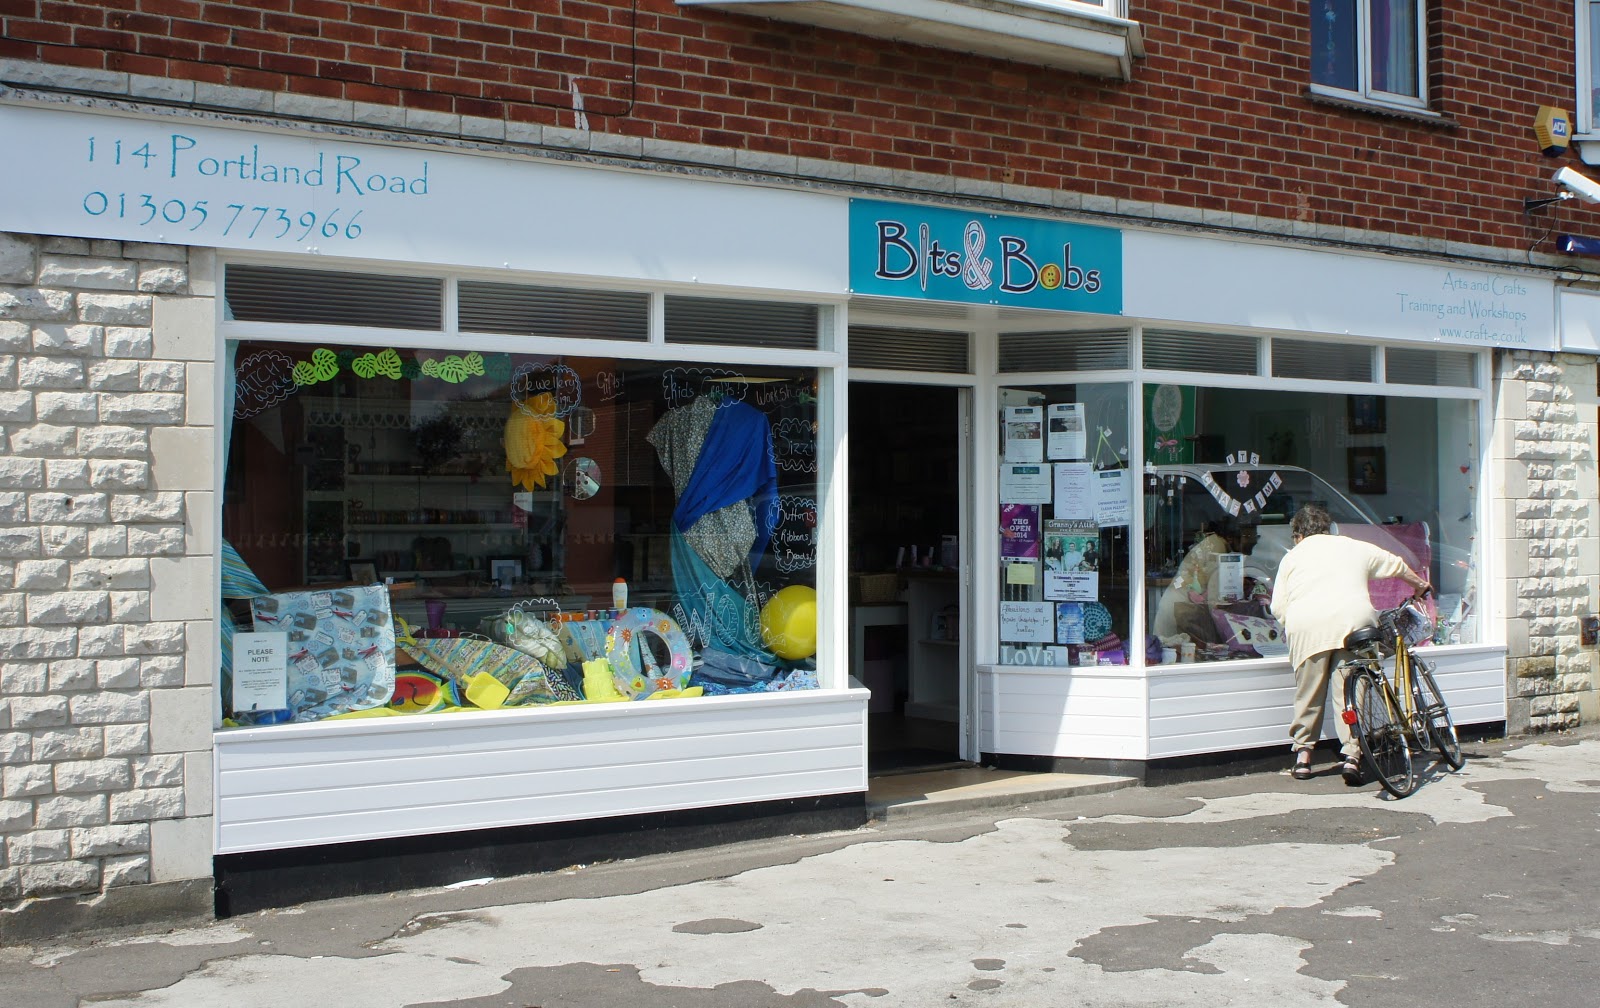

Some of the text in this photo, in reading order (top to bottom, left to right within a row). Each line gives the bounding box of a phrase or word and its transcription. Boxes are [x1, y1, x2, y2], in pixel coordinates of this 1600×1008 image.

[1553, 122, 1566, 133] ADT
[87, 134, 430, 196] 114 Portland Road
[83, 191, 364, 242] 01305 773966
[999, 236, 1101, 293] Bobs
[1442, 272, 1527, 296] Arts and Crafts
[1396, 293, 1527, 327] Training and Workshops
[1439, 323, 1527, 344] www.craft-e.co.uk
[235, 361, 280, 404] PATCH
[516, 371, 576, 395] Jewellery
[1049, 521, 1077, 529] Granny's
[1001, 646, 1054, 665] LOVE
